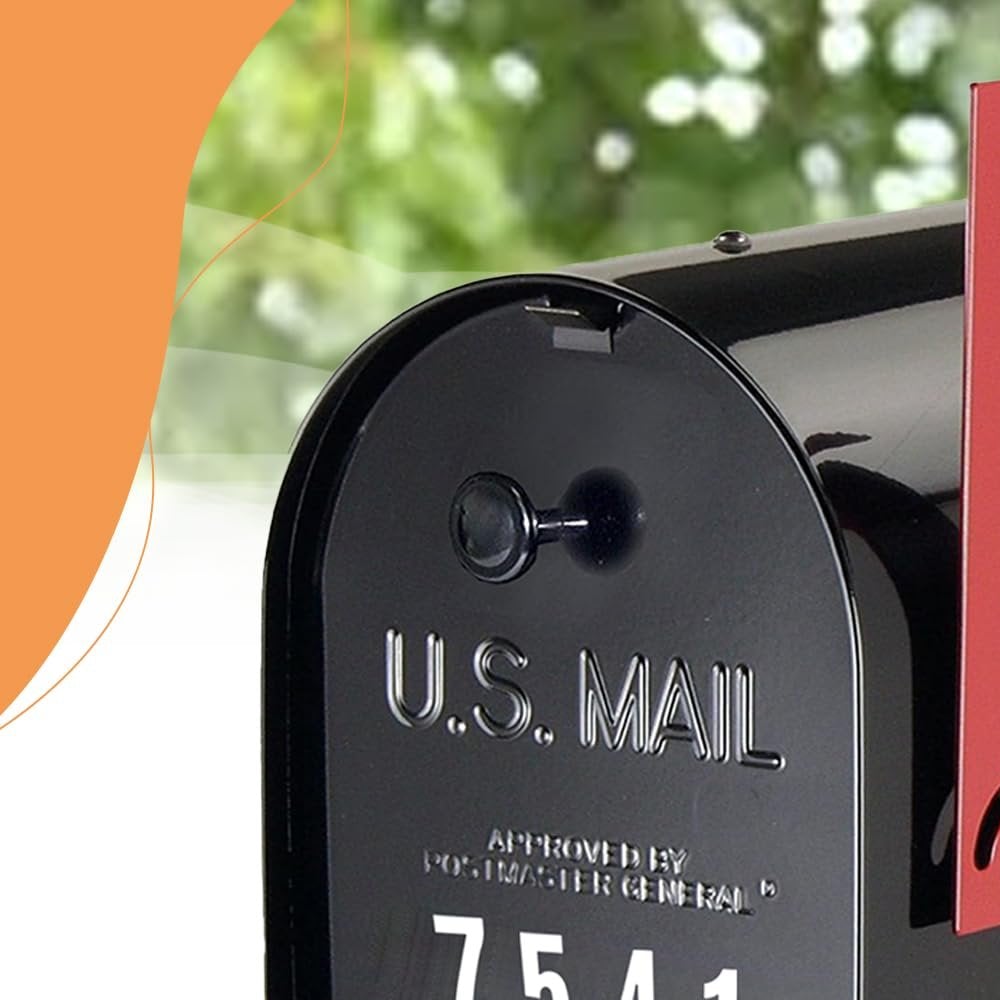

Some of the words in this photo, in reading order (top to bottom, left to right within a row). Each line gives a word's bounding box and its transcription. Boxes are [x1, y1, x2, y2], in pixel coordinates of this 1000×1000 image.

[386, 627, 554, 745] U.S.
[578, 647, 786, 771] MAIL
[422, 850, 613, 898] POSTMASTER
[621, 875, 756, 916] GENERAL
[487, 828, 641, 870] APPROVED
[650, 845, 689, 875] BY
